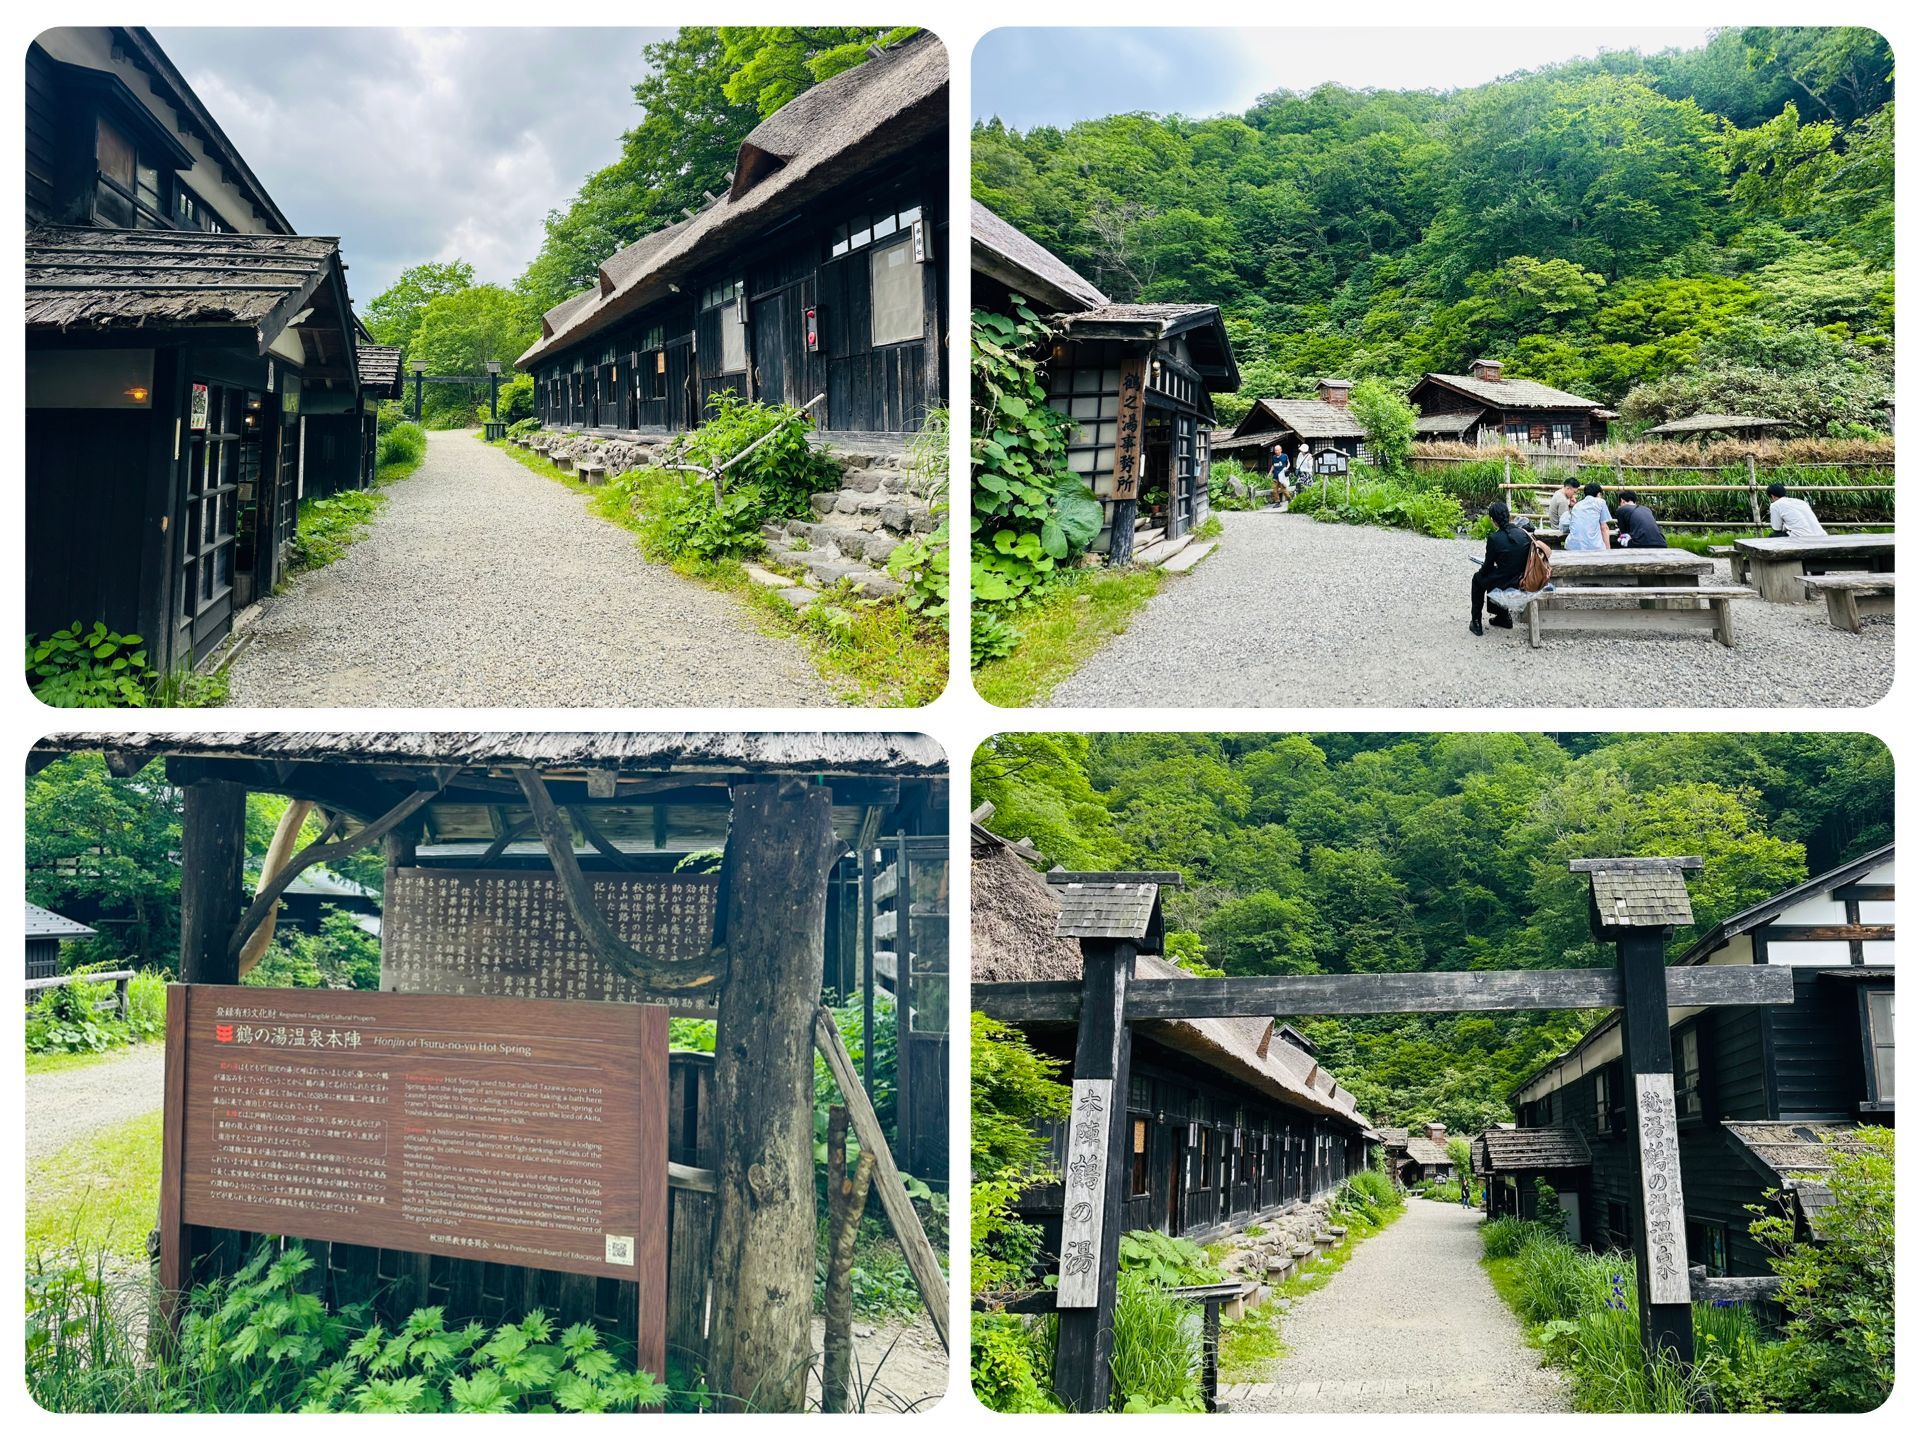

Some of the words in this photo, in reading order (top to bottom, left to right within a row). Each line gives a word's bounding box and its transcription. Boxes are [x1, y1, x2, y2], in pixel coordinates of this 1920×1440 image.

[216, 1007, 276, 1019] 登録有形文化財
[236, 1025, 362, 1049] 鶴の湯温泉本陣
[374, 1037, 404, 1048] Honjin
[407, 1038, 417, 1047] of
[419, 1039, 475, 1051] Tsuru-no-yu
[479, 1042, 496, 1051] Hot
[500, 1043, 532, 1056] Spring
[585, 1197, 601, 1205] form
[544, 1248, 562, 1257] Board
[563, 1249, 570, 1258] of
[571, 1251, 601, 1262] Education
